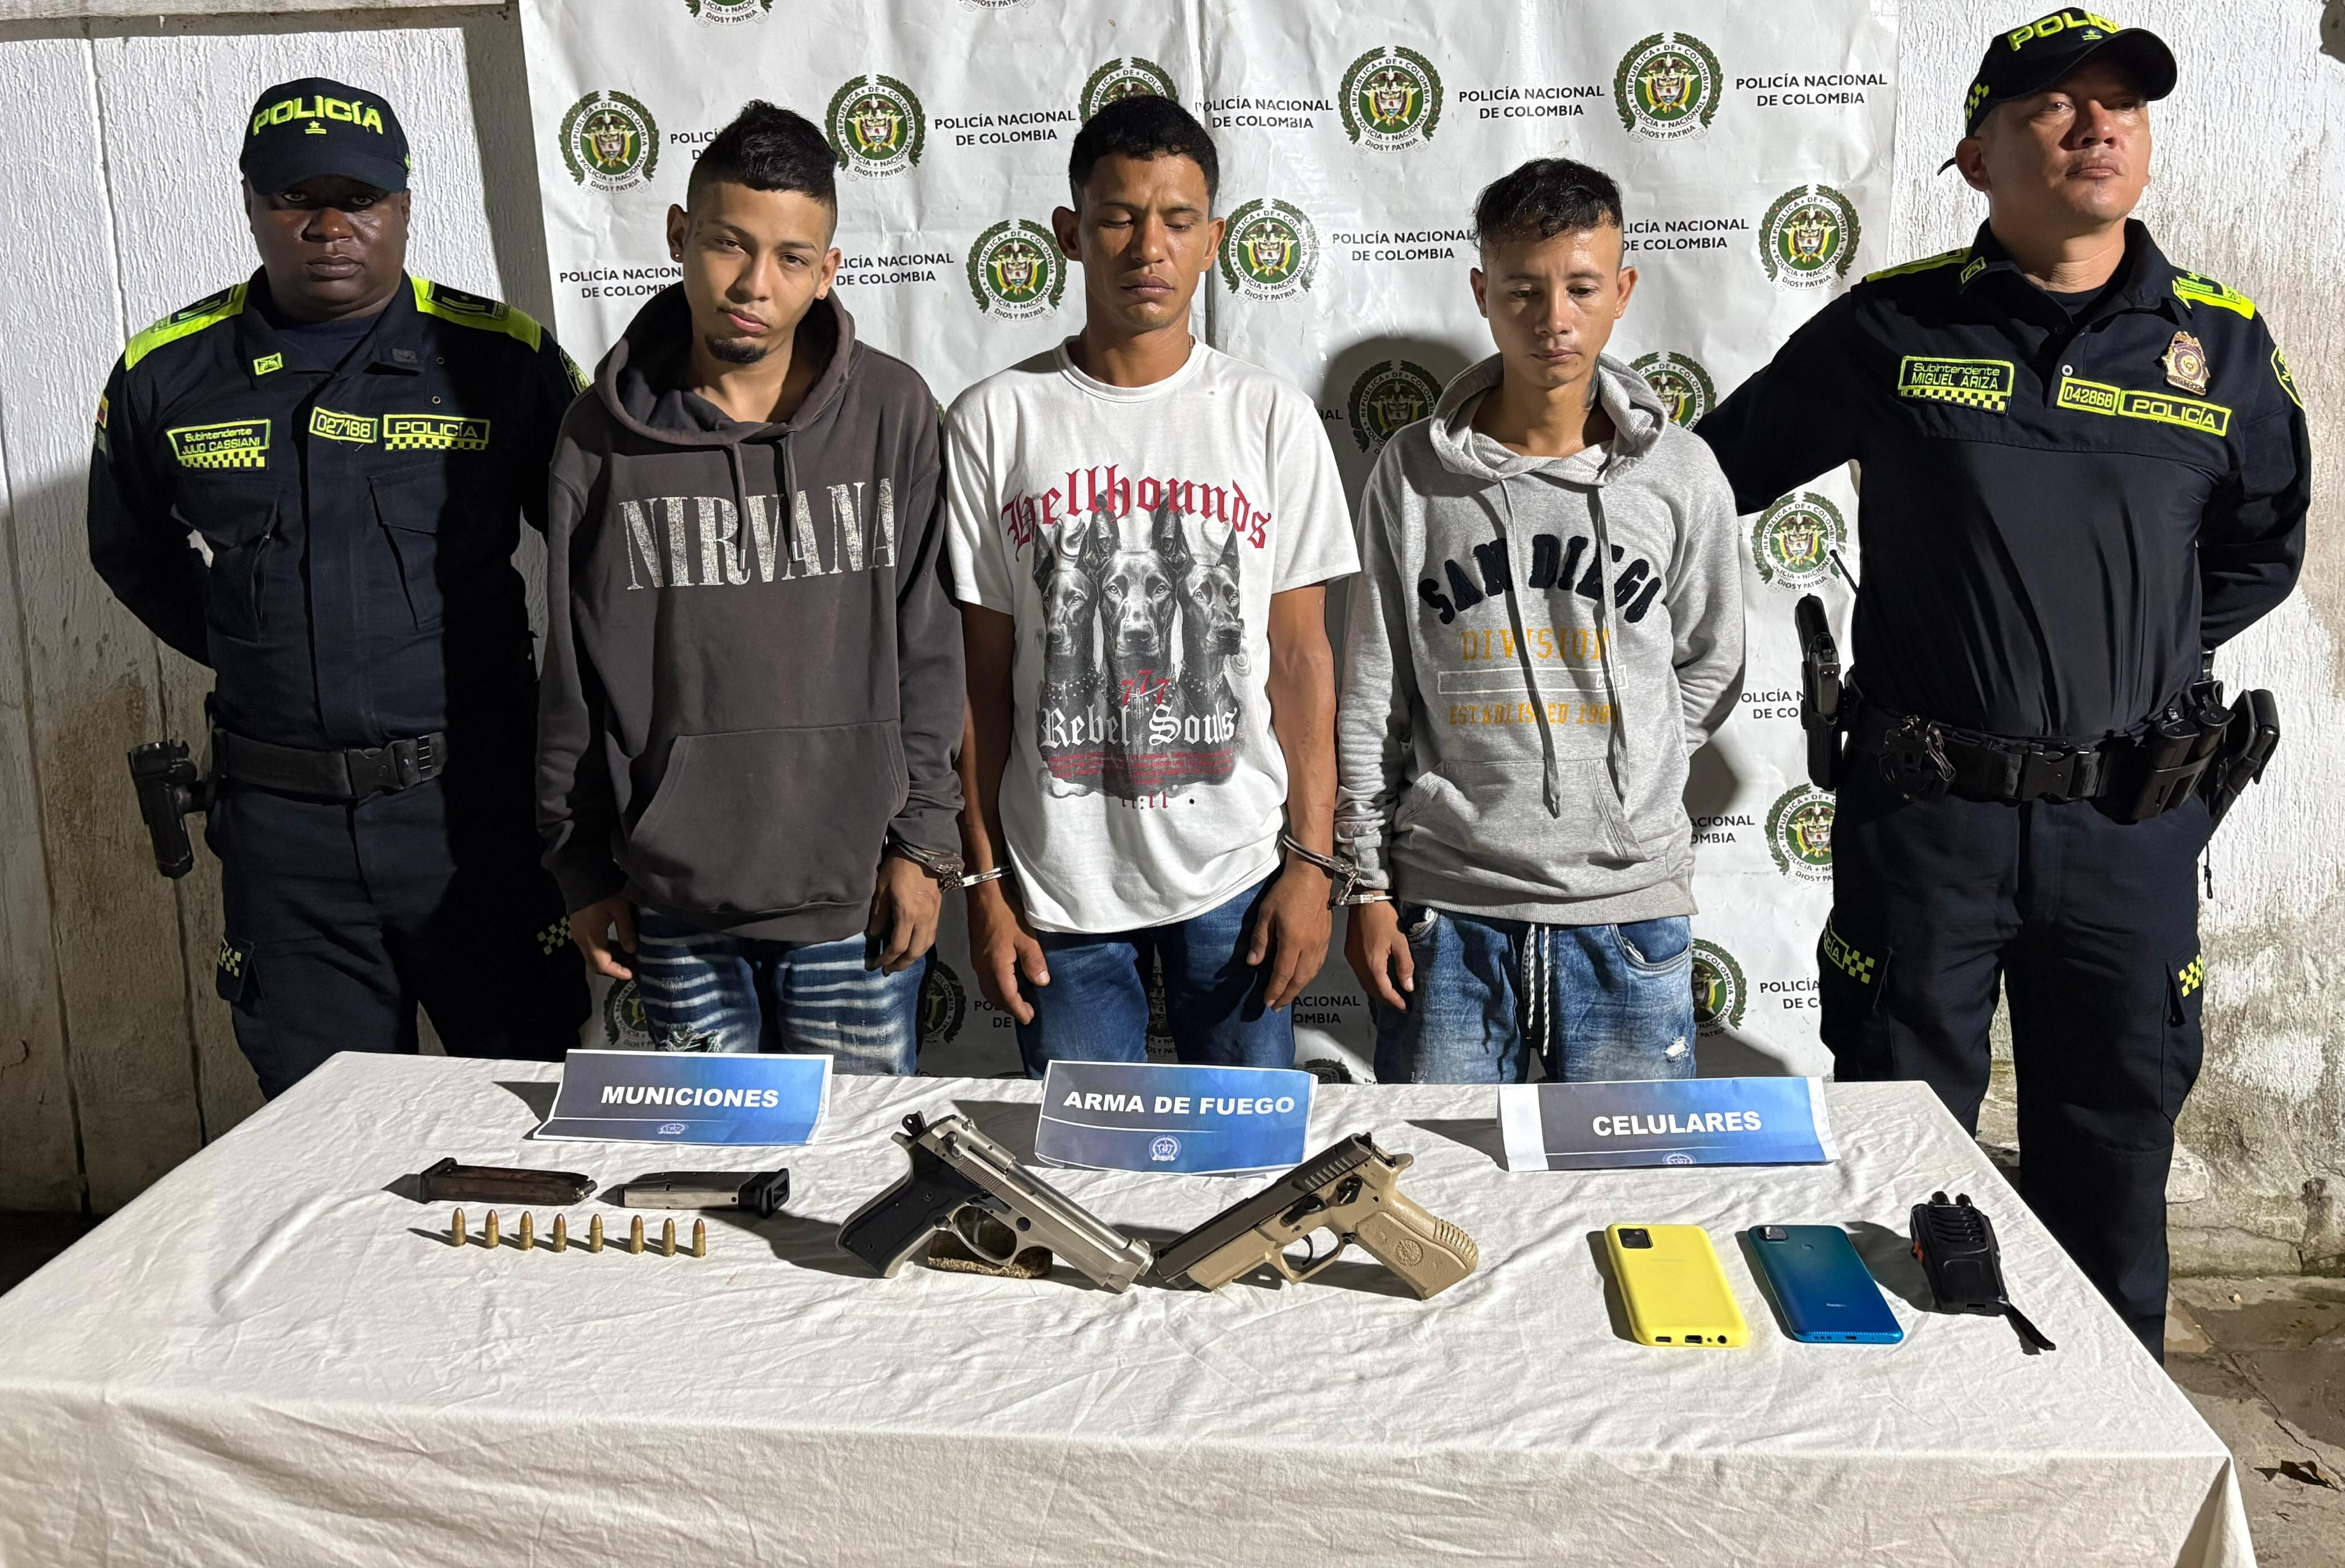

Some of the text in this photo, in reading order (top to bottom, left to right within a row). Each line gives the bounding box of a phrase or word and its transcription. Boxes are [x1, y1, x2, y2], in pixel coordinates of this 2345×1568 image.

[731, 0, 755, 13] NACIO
[705, 11, 724, 23] DIOS
[732, 9, 758, 23] PATRIA
[2007, 11, 2120, 51] POLIC
[1684, 48, 1709, 91] COLOMBIA
[1405, 62, 1430, 104] COLOMBIA
[1736, 73, 1888, 90] POLICÍA NACIONAL
[1092, 74, 1116, 114] EPUBLICA
[1459, 85, 1605, 103] POLICÍA NACIONAL
[1757, 92, 1865, 107] DE COLOMBIA
[887, 90, 914, 131] COLOMBIA
[1255, 99, 1334, 112] NACIONAL
[1480, 104, 1585, 119] DE COLOMBIA
[254, 95, 384, 136] POLICÍA
[935, 110, 1076, 130] POLICÍA NACIONAL
[1211, 115, 1314, 129] DE COLOMBIA
[1668, 101, 1705, 129] NACIONAL
[620, 106, 647, 146] COLOMBIA
[1391, 114, 1427, 141] NACIONAL
[1640, 126, 1660, 139] DIOS
[1667, 125, 1696, 139] PATRIA
[670, 131, 719, 145] POLICÍ
[955, 129, 1058, 146] DE COLOMBIA
[1365, 139, 1384, 151] DIOS
[1391, 138, 1418, 151] PATRIA
[879, 141, 913, 167] NACIONAL
[614, 156, 646, 182] NACIONAL
[854, 165, 873, 177] DIOS
[880, 164, 906, 178] PATRIA
[590, 180, 608, 192] DIOS
[615, 179, 640, 192] PATRIA
[1624, 218, 1749, 234] ICÍA NACIONAL
[1283, 215, 1308, 256] COLOMBIA
[1332, 229, 1474, 245] POLICÍA NACIONAL
[1623, 237, 1728, 251] DE COLOMBIA
[837, 253, 954, 269] ICÍA NACIONAL
[1029, 234, 1055, 274] COLOMBIA
[1352, 247, 1455, 261] DE COLOMBIA
[1806, 252, 1842, 278] NACIONAL
[559, 267, 682, 283] POLICÍA NACION
[836, 271, 936, 286] DE COLOMBIA
[1270, 265, 1305, 291] NACIONAL
[1780, 276, 1798, 288] DIOS
[1805, 275, 1832, 288] PATRIA
[581, 284, 671, 298] DE COLOMB
[1019, 284, 1052, 309] NACIONAL
[1271, 288, 1297, 301] PATRIA
[994, 308, 1012, 319] DIOS
[1020, 306, 1046, 320] PATRIA
[1679, 367, 1703, 408] COLOMBIA
[1911, 372, 1998, 390] MIGUEL ARIZA
[2064, 386, 2113, 408] 042868
[2132, 398, 2216, 428] POLICÍA
[317, 413, 371, 438] 027188
[396, 419, 479, 438] POLICÍA
[182, 437, 260, 455] JULIO CASSIANI
[619, 478, 895, 590] NIRVANA
[1802, 557, 1831, 579] NACIONA
[1418, 538, 1515, 624] SAN
[1777, 578, 1795, 590] DIOS
[1802, 576, 1827, 589] PATRIA
[1740, 689, 1793, 703] OLICÍA
[1449, 703, 1569, 727] ESTABLISED
[1753, 708, 1773, 719] DE
[1039, 701, 1238, 749] Rebel Souls
[1690, 815, 1755, 827] ACIONAL
[1689, 832, 1736, 845] OMBIA
[1705, 954, 1734, 995] COLOMBIA
[1295, 995, 1361, 1007] ACIONAL
[1782, 998, 1803, 1009] DE
[993, 1017, 1012, 1028] DE
[600, 1086, 779, 1108] MUNICIONES
[1063, 1091, 1295, 1115] ARMA DE FUEGO
[1592, 1111, 1762, 1137] CELULARES
